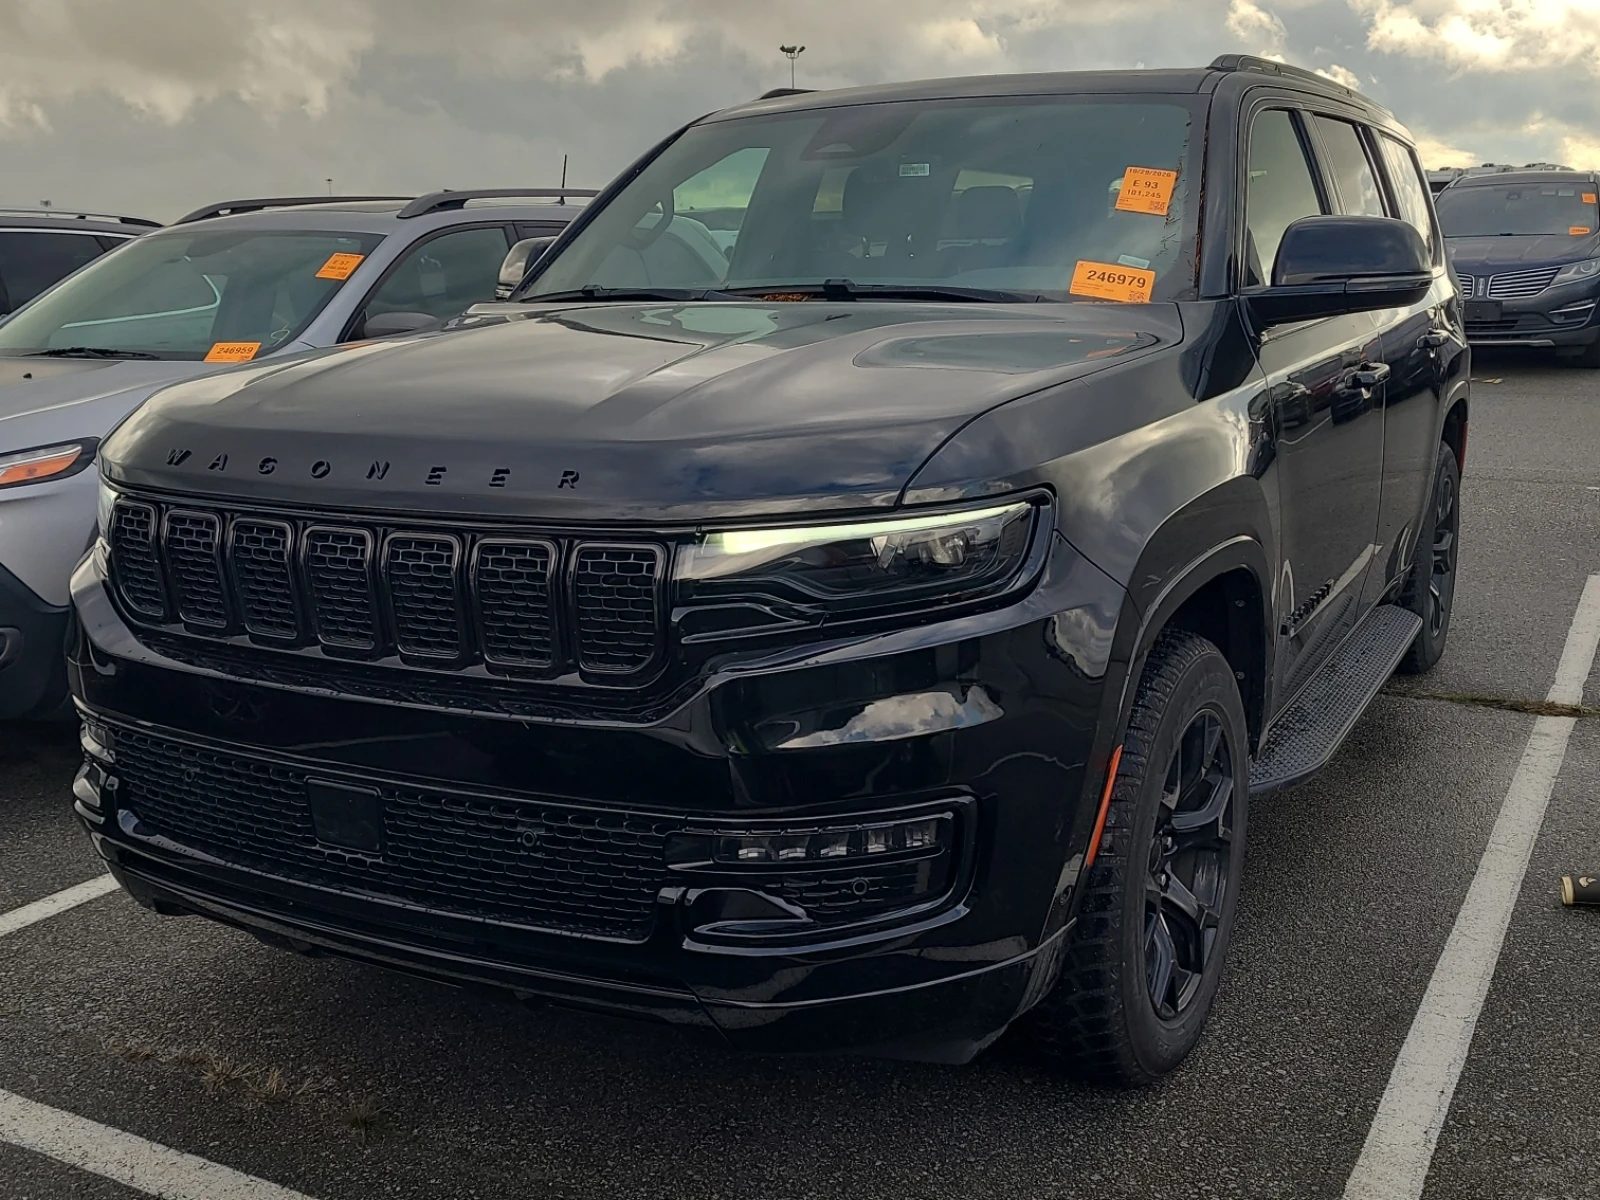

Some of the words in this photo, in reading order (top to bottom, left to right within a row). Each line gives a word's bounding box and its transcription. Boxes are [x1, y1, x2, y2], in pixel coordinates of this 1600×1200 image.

[1144, 181, 1159, 189] 93
[1086, 269, 1147, 288] 246979
[217, 346, 254, 354] 246959
[166, 448, 579, 489] WAGONEER
